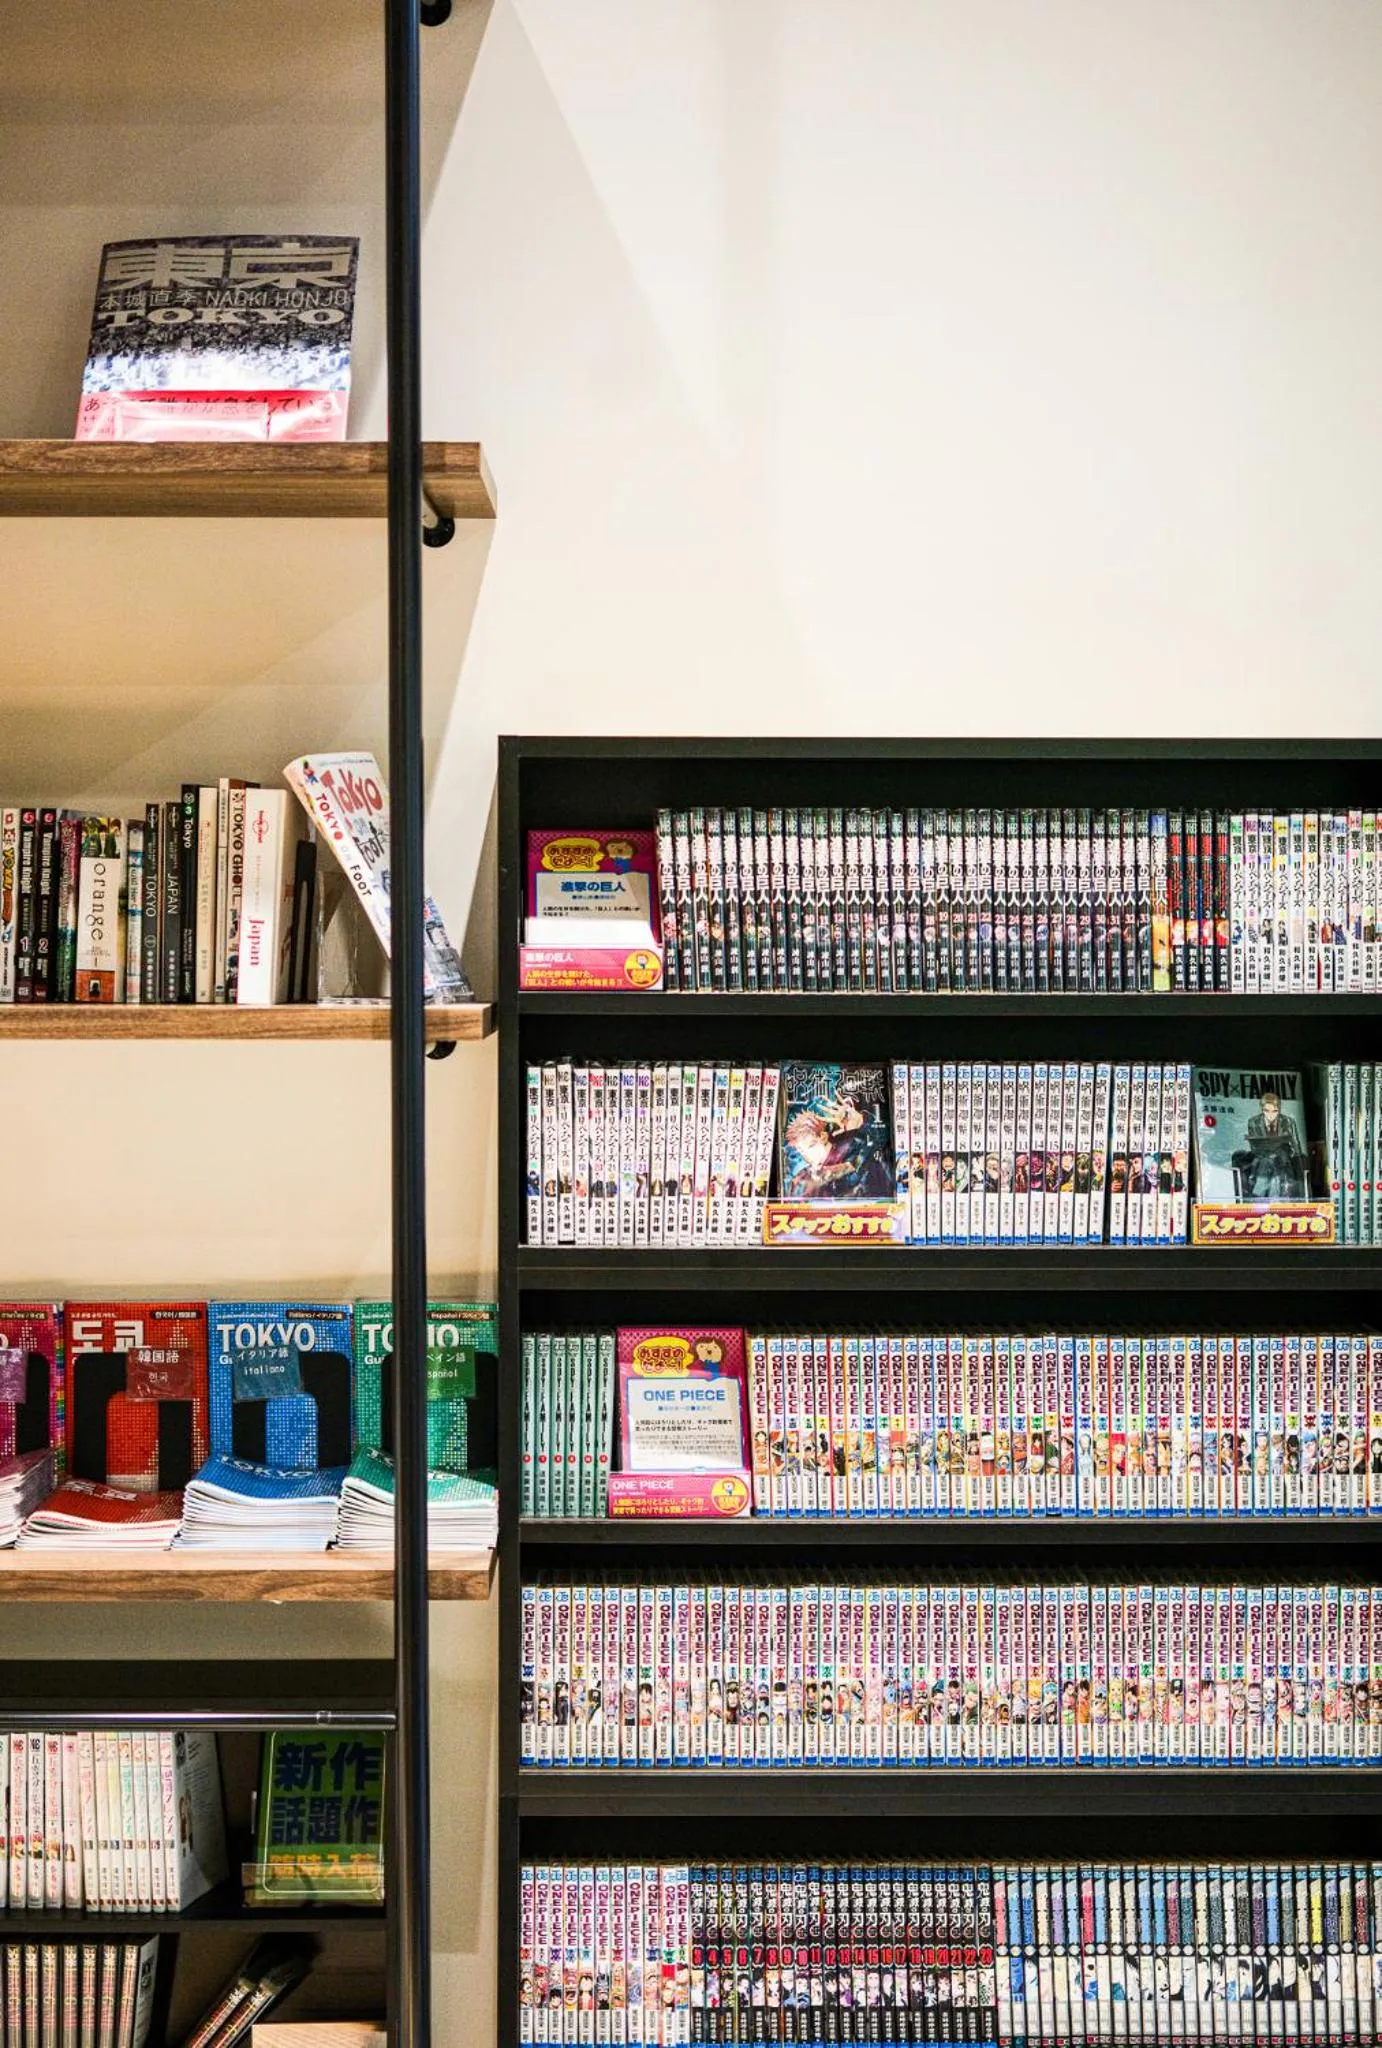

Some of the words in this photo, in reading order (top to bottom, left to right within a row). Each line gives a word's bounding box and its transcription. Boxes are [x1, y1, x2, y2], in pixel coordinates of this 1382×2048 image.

[103, 243, 350, 289] 東京
[205, 291, 268, 308] NAOKI
[279, 289, 348, 307] HONJO
[98, 307, 346, 328] TOKYO
[183, 819, 193, 848] Tokyo
[233, 806, 244, 849] TOKYO
[22, 831, 33, 865] Vampire
[42, 832, 53, 866] Vampire
[316, 793, 343, 840] TOKYO
[350, 865, 372, 896] FOOT
[21, 867, 32, 894] Knight
[40, 868, 52, 895] Knight
[233, 854, 244, 898] GHOUL
[561, 881, 626, 892] 進撃の巨人
[86, 863, 106, 940] orange
[145, 874, 157, 917] TOKYO
[167, 873, 178, 914] JAPAN
[20, 937, 28, 951] 1
[38, 938, 49, 953] 2
[248, 919, 265, 966] Japan
[1198, 1071, 1298, 1100] SPY×FAMILY
[873, 1104, 882, 1123] 1
[1202, 1213, 1326, 1235] スタッフおすすめ
[72, 1320, 151, 1353] 도쿄
[217, 1323, 315, 1352] TOKYO
[138, 1350, 180, 1364] 韓国語
[237, 1347, 289, 1361] イタリア語
[427, 1352, 466, 1363] ペイン語
[754, 1355, 766, 1376] ONE
[816, 1355, 827, 1376] ONE
[863, 1355, 874, 1376] ONE
[1192, 1354, 1201, 1375] ONE
[1306, 1354, 1316, 1375] ONE
[1356, 1353, 1366, 1375] ONE
[244, 1366, 285, 1377] italiano
[643, 1390, 676, 1401] ONE
[680, 1389, 725, 1401] PIECE
[755, 1378, 766, 1414] PIECE
[818, 1378, 828, 1415] PIECE
[864, 1378, 875, 1415] PIECE
[1192, 1377, 1201, 1413] PIECE
[1307, 1377, 1316, 1412] PIECE
[1357, 1376, 1366, 1412] PIECE
[613, 1480, 637, 1490] ONE
[640, 1480, 674, 1489] PIECE
[523, 1604, 535, 1625] ONE
[625, 1605, 635, 1627] ONE
[660, 1605, 670, 1626] ONE
[1281, 1604, 1291, 1625] ONE
[525, 1627, 534, 1662] PIECE
[626, 1629, 635, 1664] PIECE
[661, 1629, 670, 1664] PIECE
[1282, 1627, 1291, 1663] PIECE
[274, 1742, 382, 1791] 新作
[271, 1795, 379, 1845] 話題作
[522, 1884, 533, 1907] ONE
[598, 1884, 609, 1907] ONE
[523, 1909, 532, 1945] PIECE
[599, 1909, 608, 1946] PIECE
